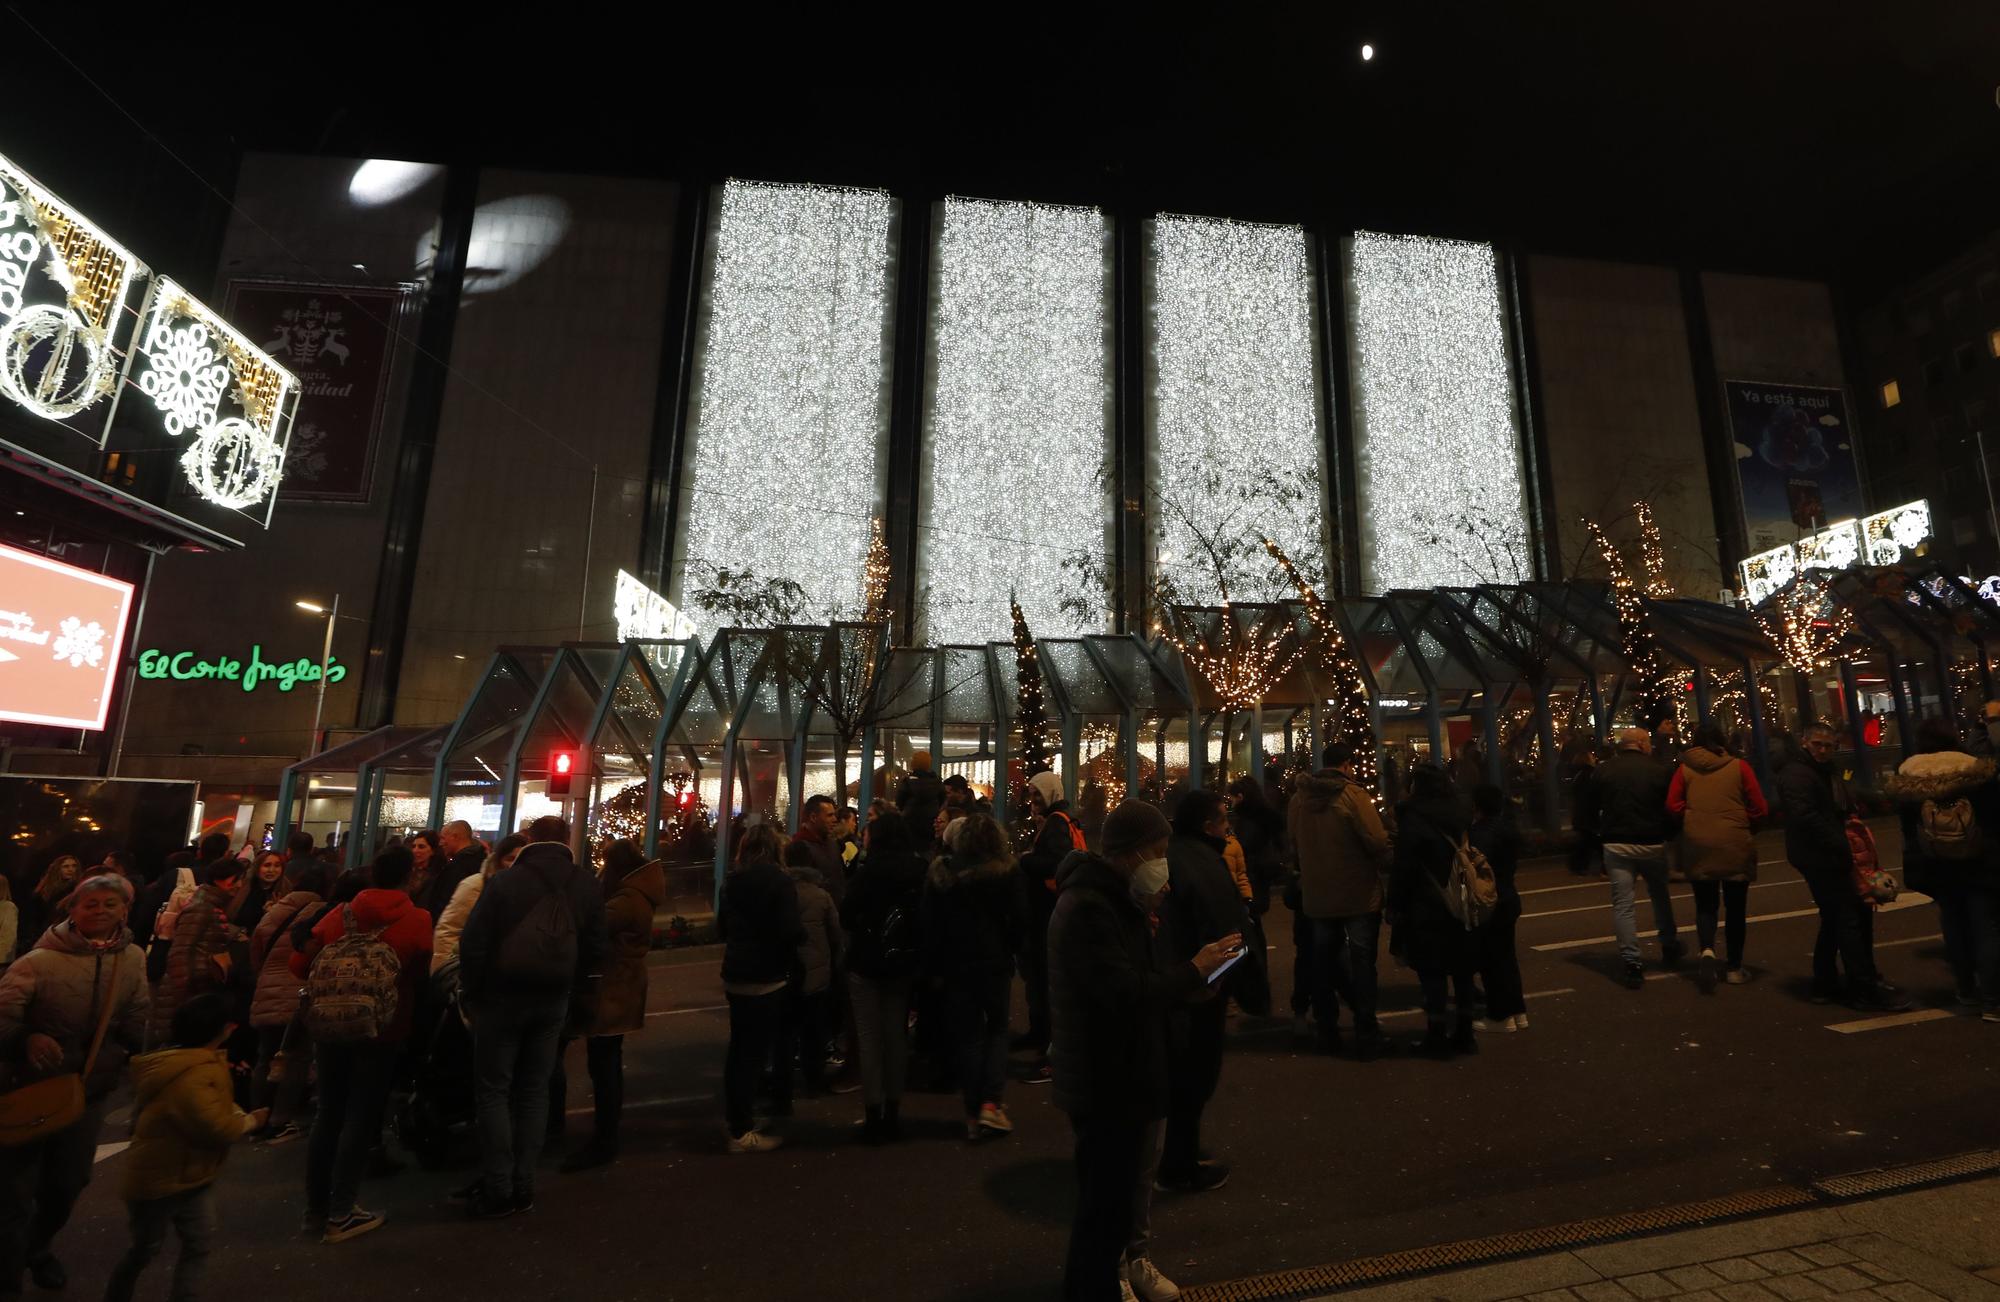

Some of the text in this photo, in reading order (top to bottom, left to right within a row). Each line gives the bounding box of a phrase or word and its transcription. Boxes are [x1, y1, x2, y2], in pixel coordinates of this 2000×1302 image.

[1741, 389, 1831, 409] Ya está aquí
[139, 649, 169, 679] El
[170, 651, 241, 680] Corte
